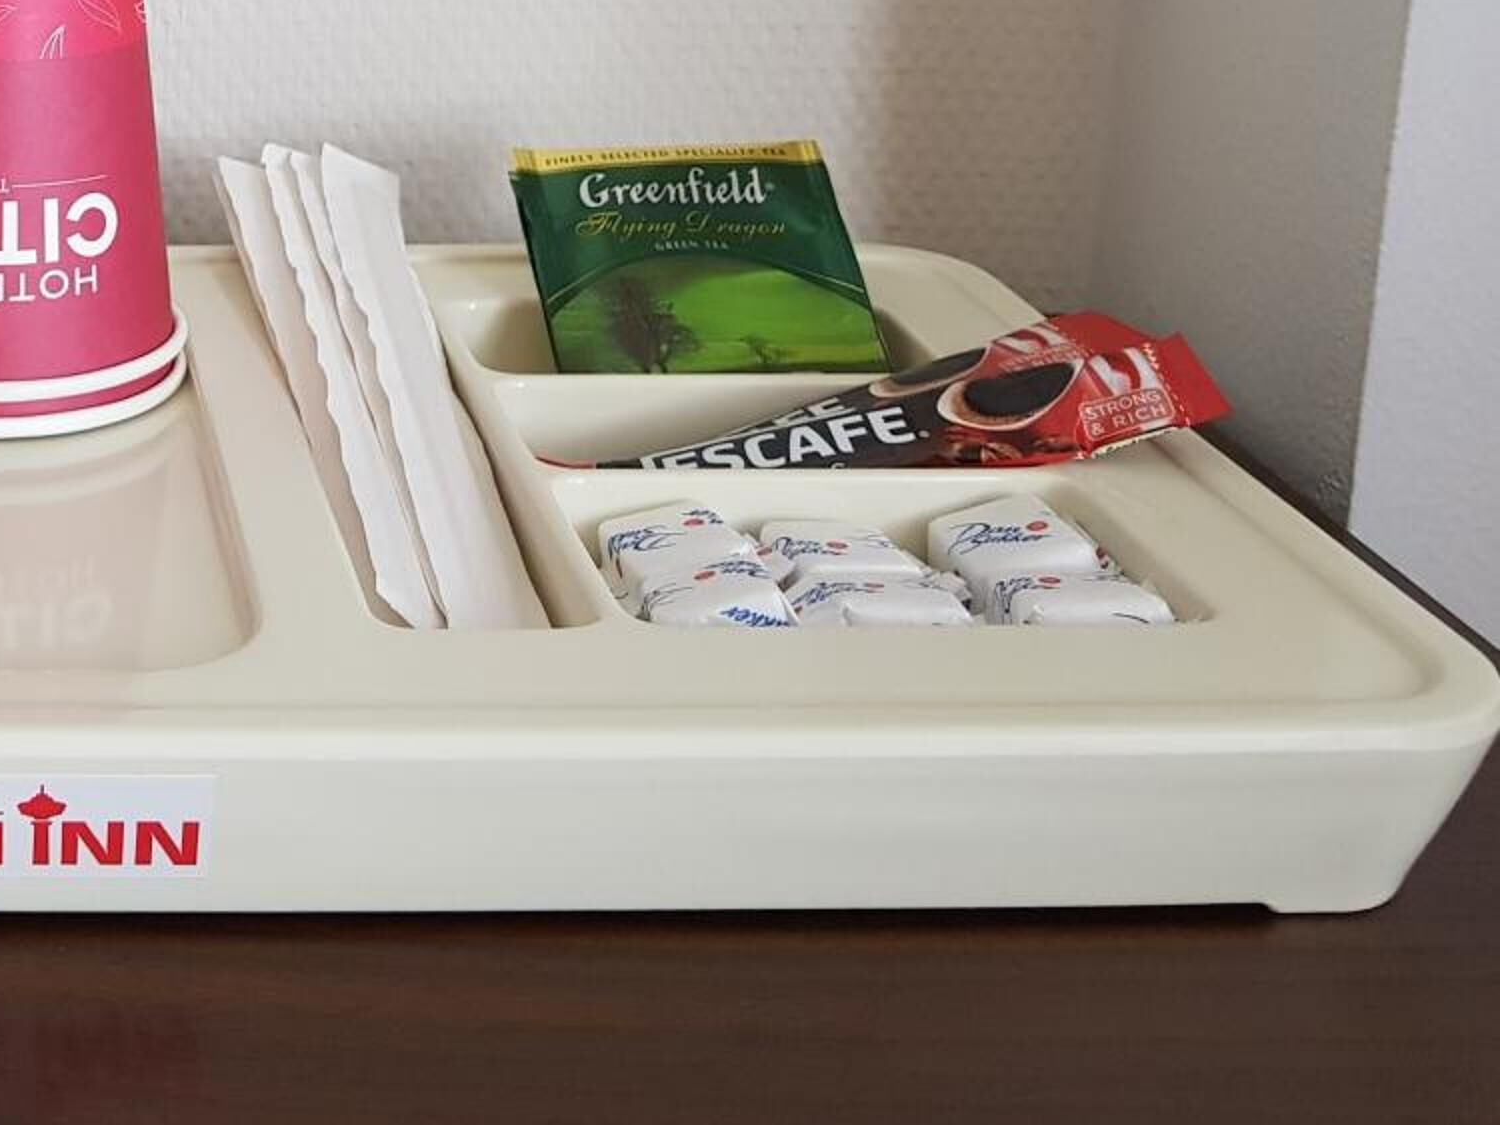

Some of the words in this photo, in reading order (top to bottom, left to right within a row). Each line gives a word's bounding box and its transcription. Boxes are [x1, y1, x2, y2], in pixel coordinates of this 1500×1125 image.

[578, 166, 766, 209] Greenfield
[575, 210, 677, 239] Flying
[684, 209, 786, 238] Dragon
[1084, 390, 1161, 421] STRONG
[1091, 422, 1105, 436] &
[1112, 404, 1167, 428] RICH
[30, 821, 200, 866] INN
